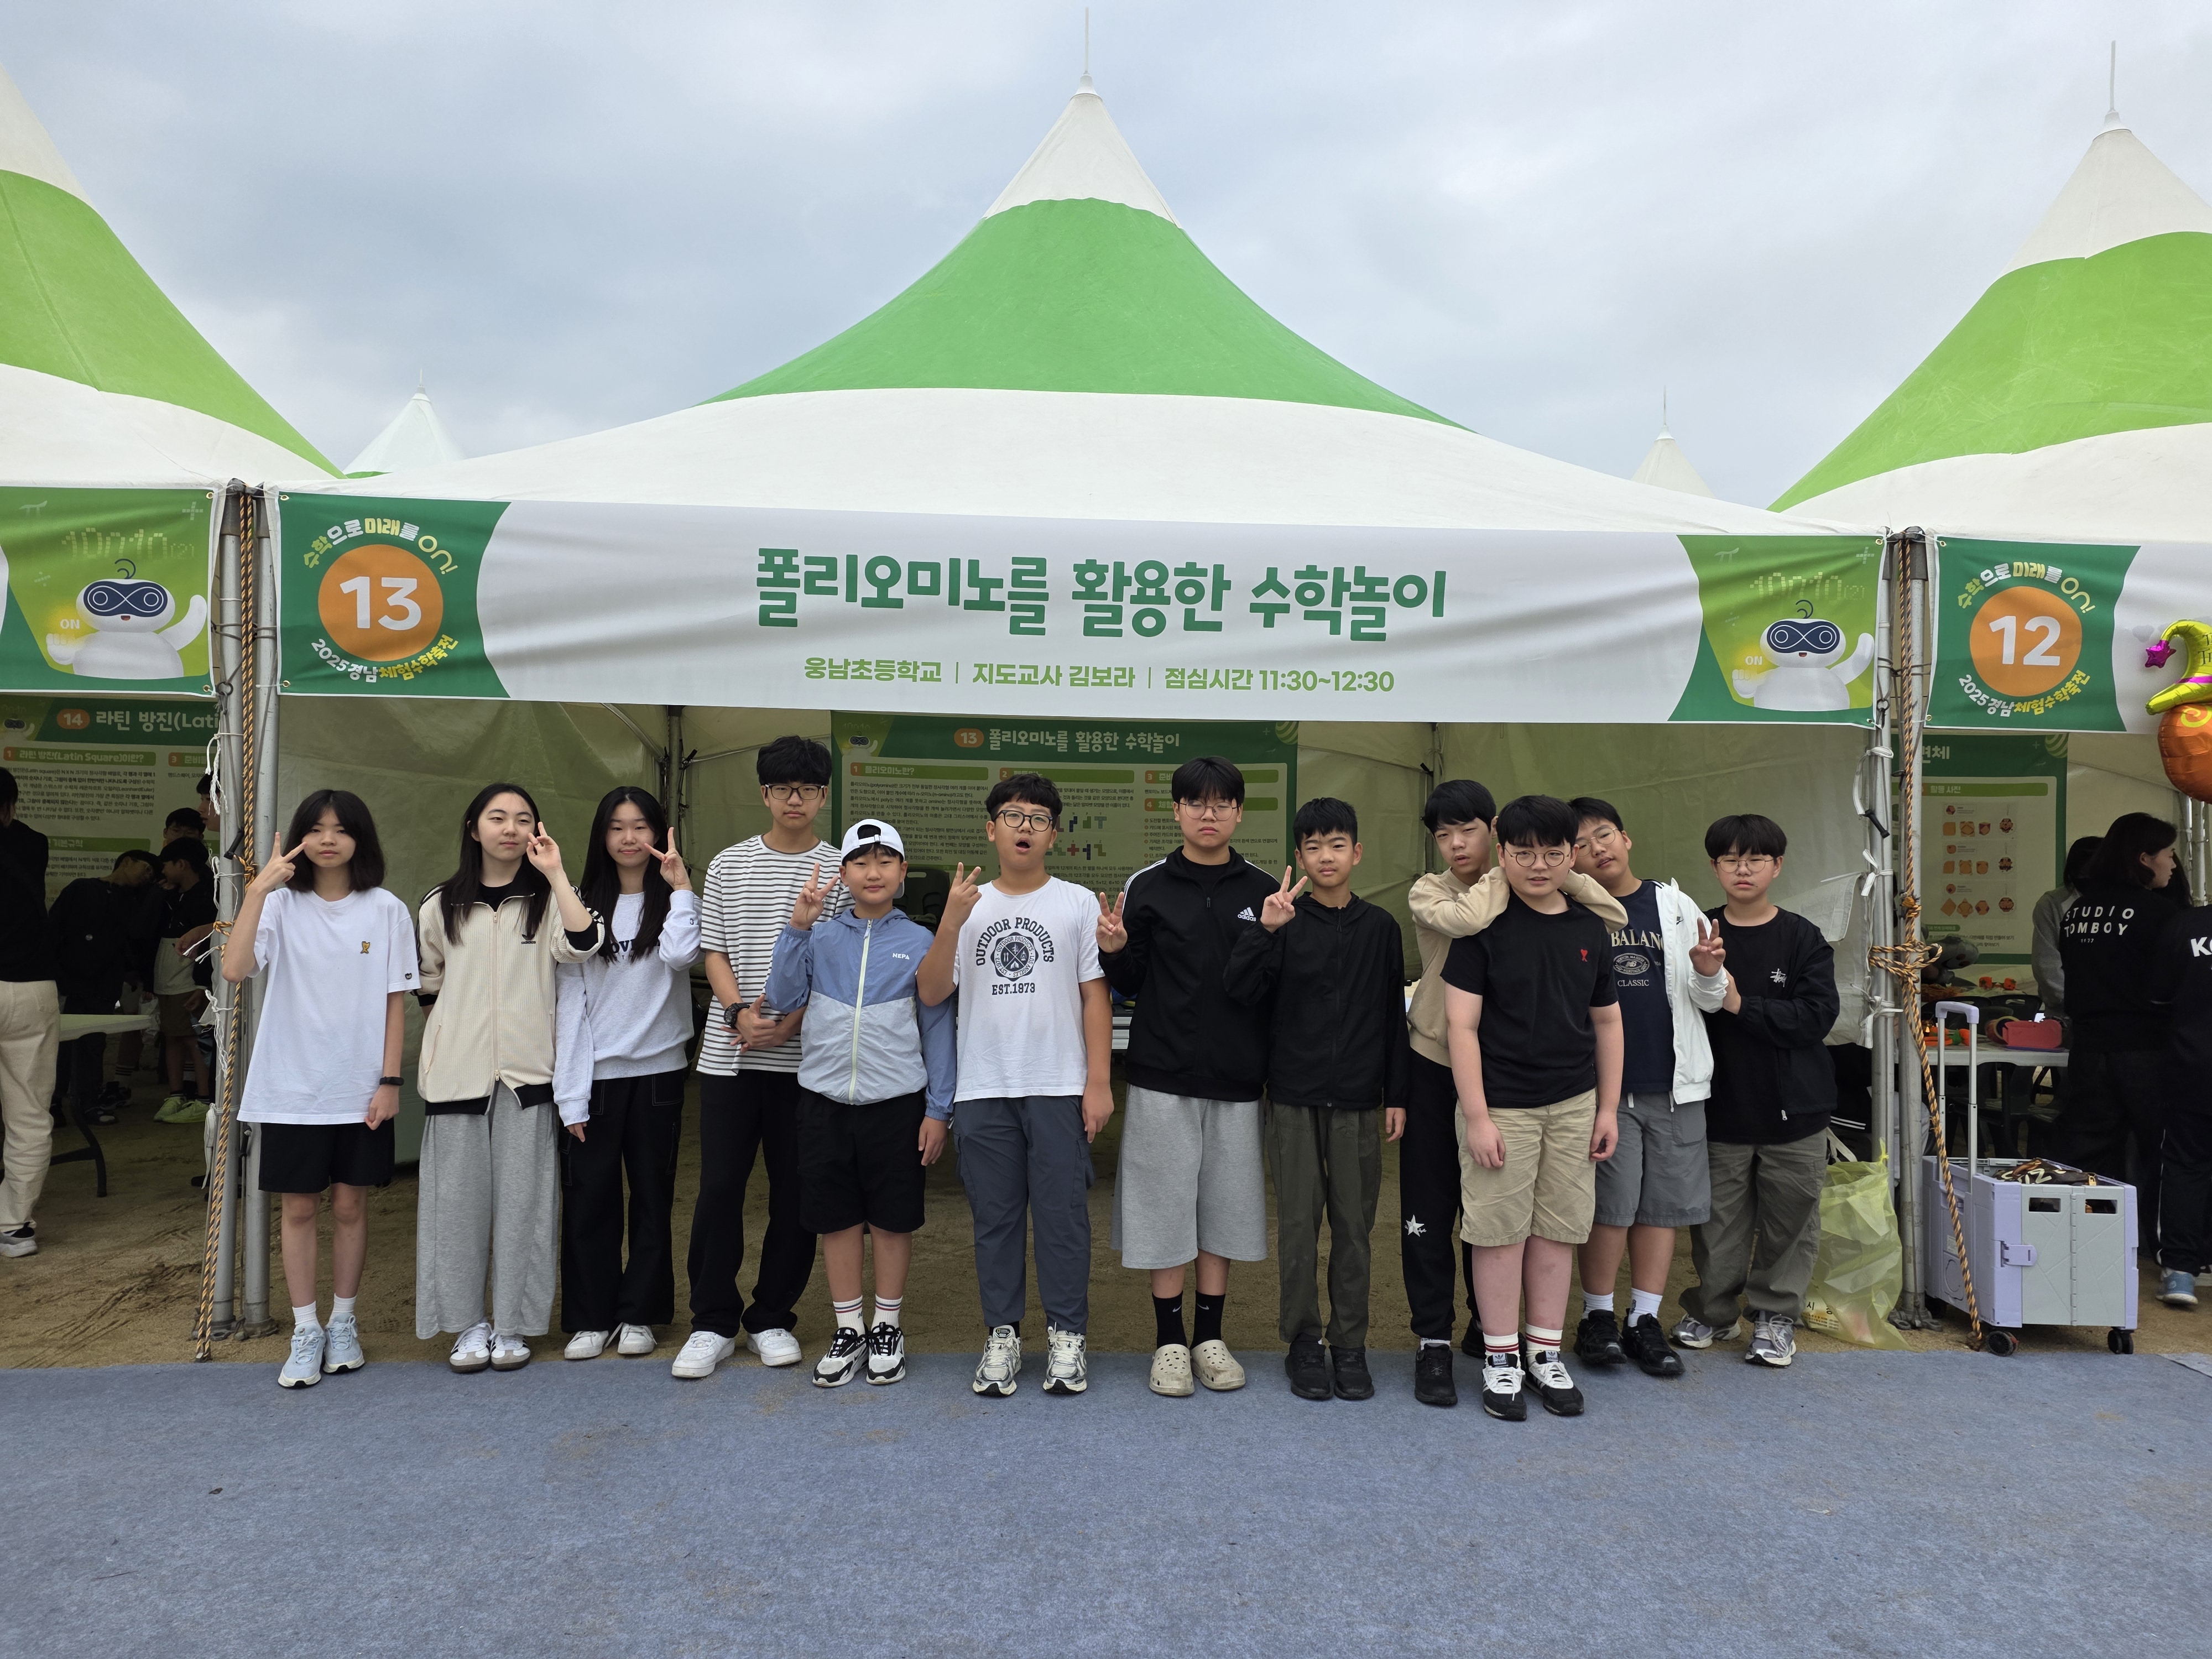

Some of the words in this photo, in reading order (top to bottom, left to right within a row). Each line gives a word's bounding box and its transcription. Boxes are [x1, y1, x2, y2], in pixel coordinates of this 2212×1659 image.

[757, 548, 1049, 636] 폴리오미노를
[1072, 559, 1232, 637] 활용한
[1250, 565, 1446, 641] 수학놀이
[340, 576, 421, 630] 13
[60, 619, 80, 629] ON
[1989, 615, 2060, 666] 12
[1745, 656, 1762, 665] ON
[804, 658, 941, 682] 웅남초등학교
[972, 663, 1062, 686] 지도교사
[1069, 665, 1135, 687] 김보라
[1165, 667, 1253, 690] 점심시간
[1260, 670, 1394, 692] 11:30~12:30
[63, 713, 82, 726] 14
[96, 711, 130, 731] 라틴
[961, 732, 977, 744] 13
[989, 729, 1068, 752] 폴리오미노를
[1076, 731, 1118, 753] 활용한
[1125, 732, 1179, 754] 수학놀이
[19, 750, 35, 759] 라틴
[38, 751, 83, 761] 방진(Latin
[85, 753, 143, 763] Square)이란?
[865, 766, 914, 775] 폴리오미노란?
[53, 839, 83, 848] 기본규칙
[2065, 906, 2134, 921] STUDIO
[2064, 922, 2128, 938] TOMBOY
[976, 919, 1011, 966] OUTDOOR
[1015, 917, 1054, 962] PRODUCTS
[997, 937, 1014, 952] OUTDOOR
[1015, 936, 1034, 951] PRODUCTS
[992, 983, 1035, 995] EST.1973
